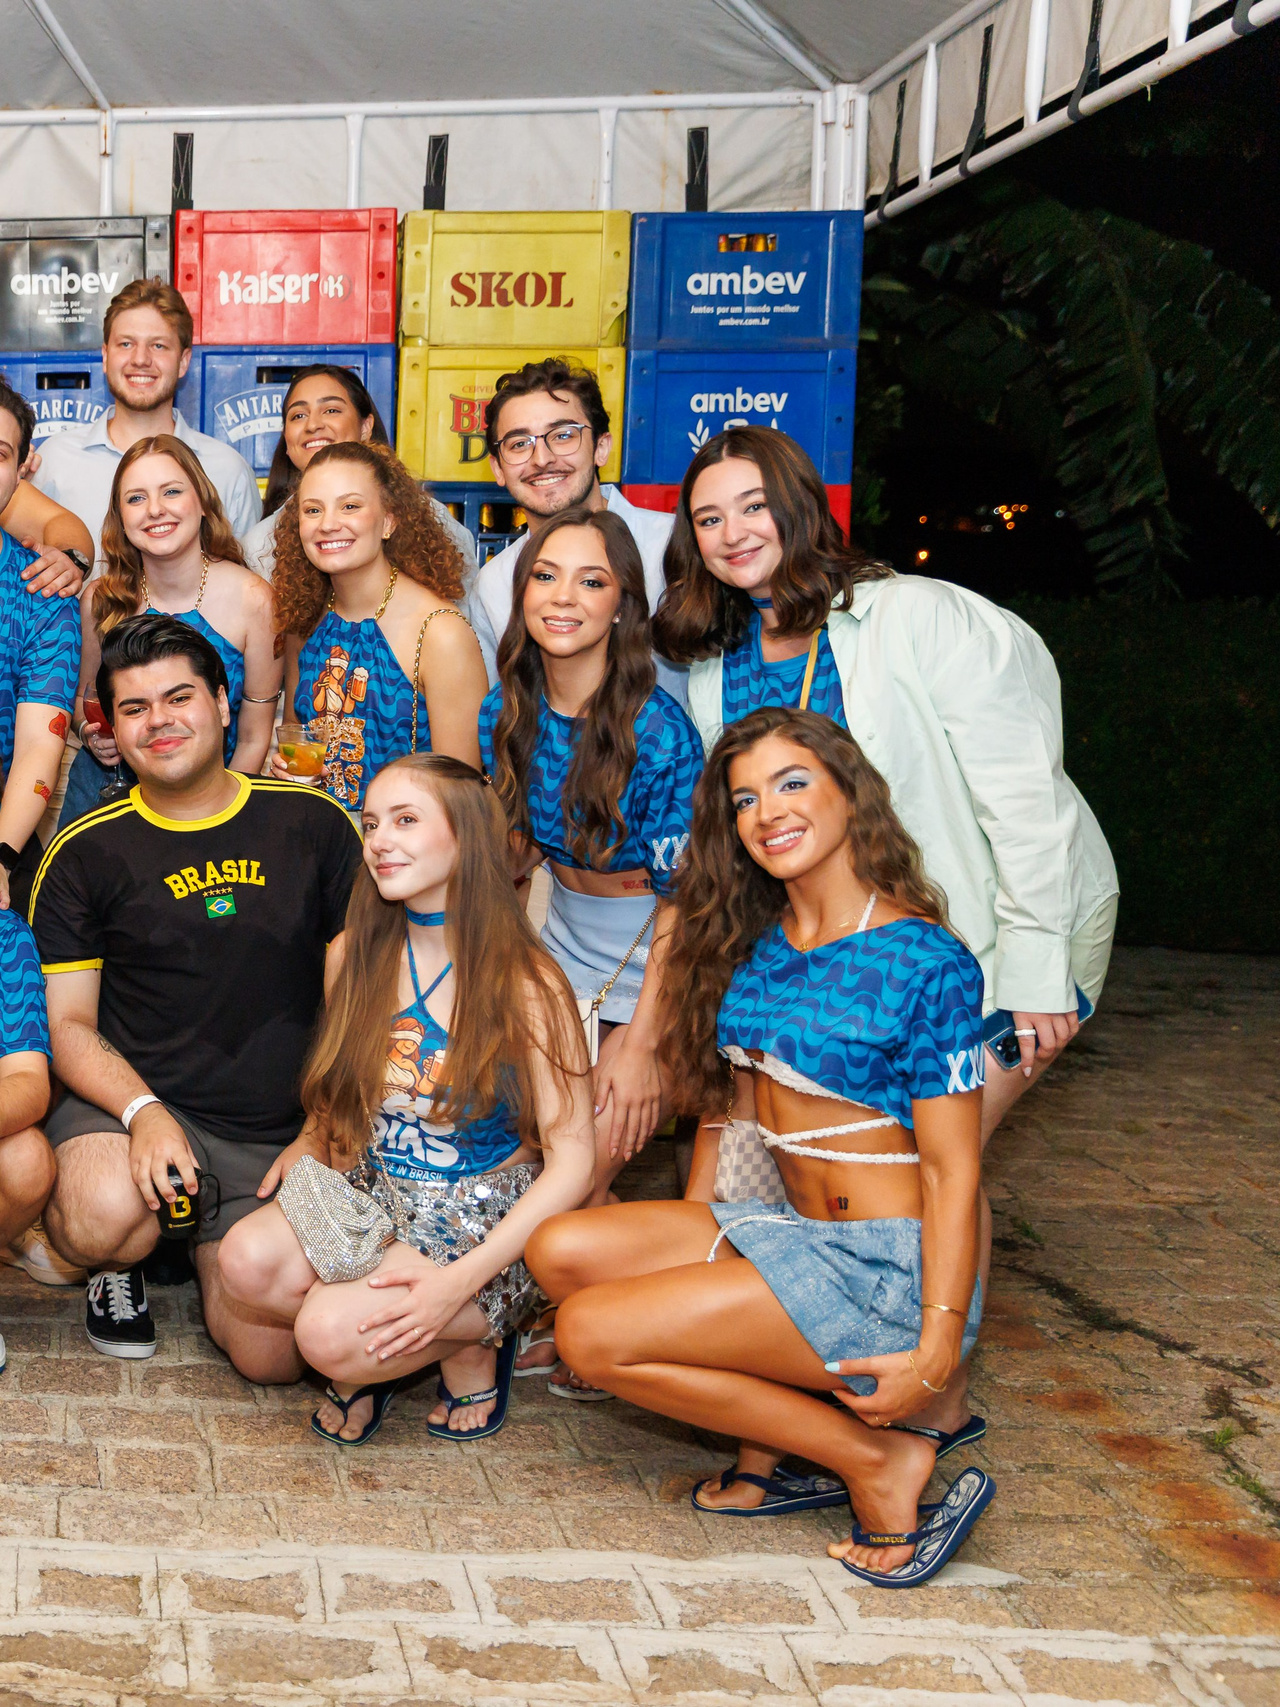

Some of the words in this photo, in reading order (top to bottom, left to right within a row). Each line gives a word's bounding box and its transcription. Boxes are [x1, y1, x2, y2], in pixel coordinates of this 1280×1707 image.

[10, 266, 119, 295] ambev
[218, 270, 319, 306] Kaiser
[450, 271, 574, 308] SKOL
[687, 265, 807, 296] ambev
[690, 305, 714, 314] Juntos
[716, 306, 730, 316] por
[744, 304, 771, 313] mundo
[773, 304, 800, 313] melhor
[718, 317, 770, 326] ambev.com.br
[690, 387, 789, 413] ambev
[163, 859, 266, 900] BRASIL
[396, 1166, 408, 1176] IN
